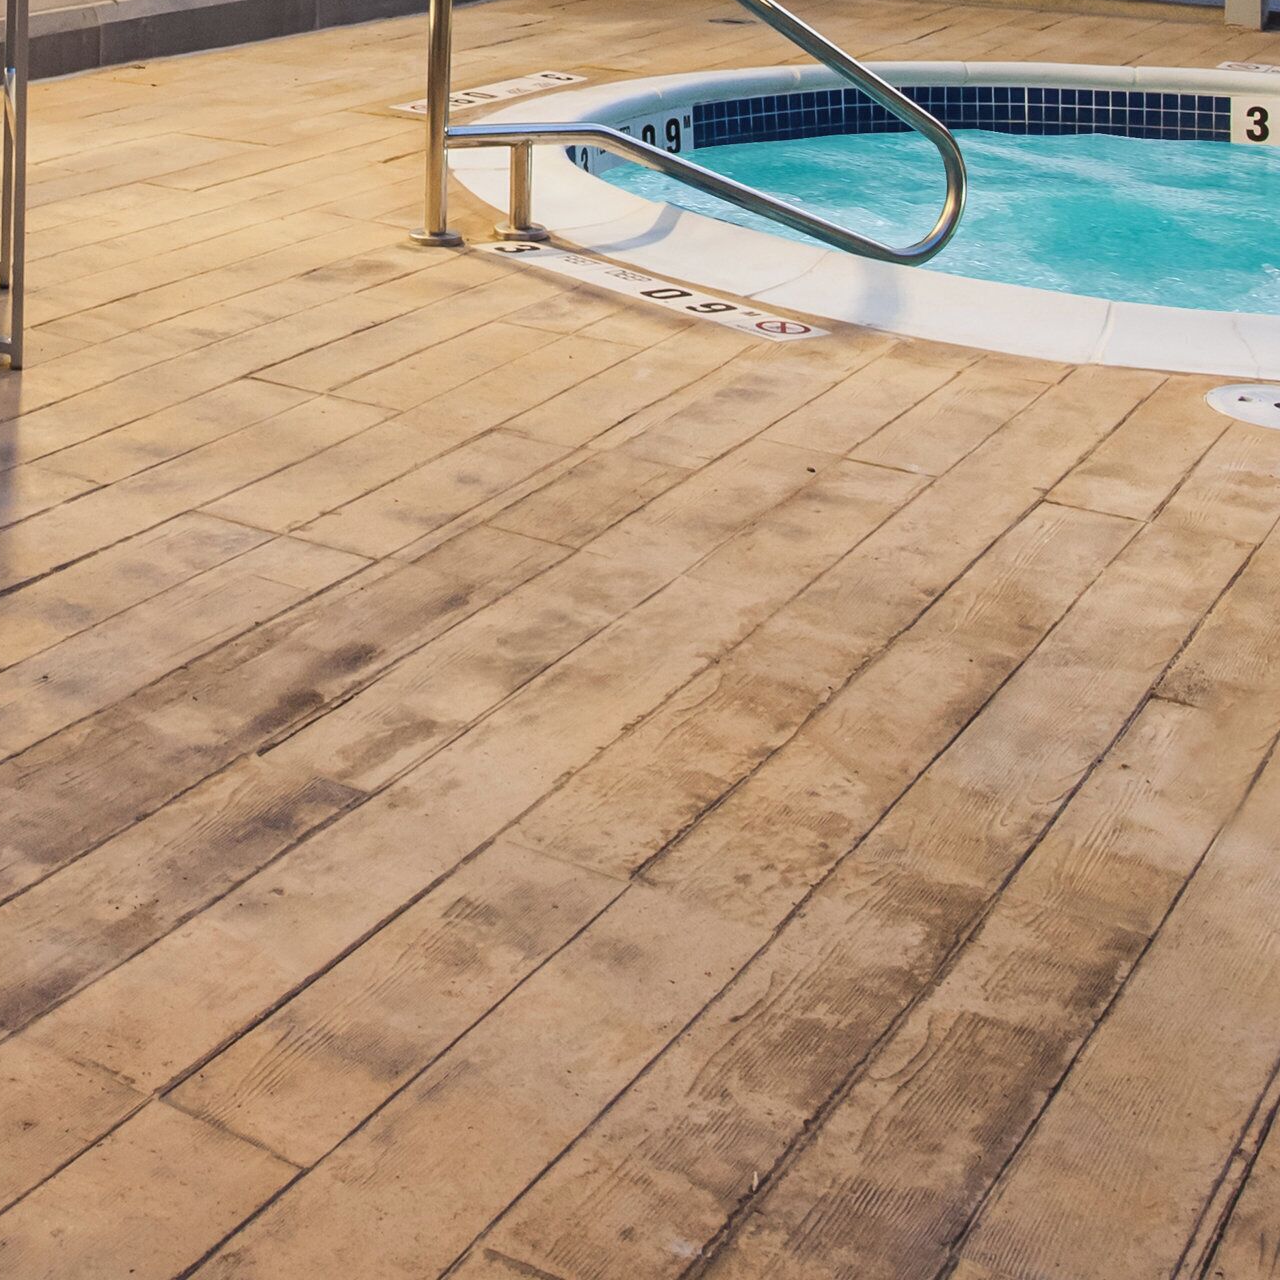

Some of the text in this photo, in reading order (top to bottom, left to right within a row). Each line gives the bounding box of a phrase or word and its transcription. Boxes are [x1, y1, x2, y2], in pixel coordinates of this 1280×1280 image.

[1246, 106, 1270, 142] 3
[495, 244, 541, 254] 3
[564, 255, 602, 266] FEET
[604, 269, 653, 282] DEEP
